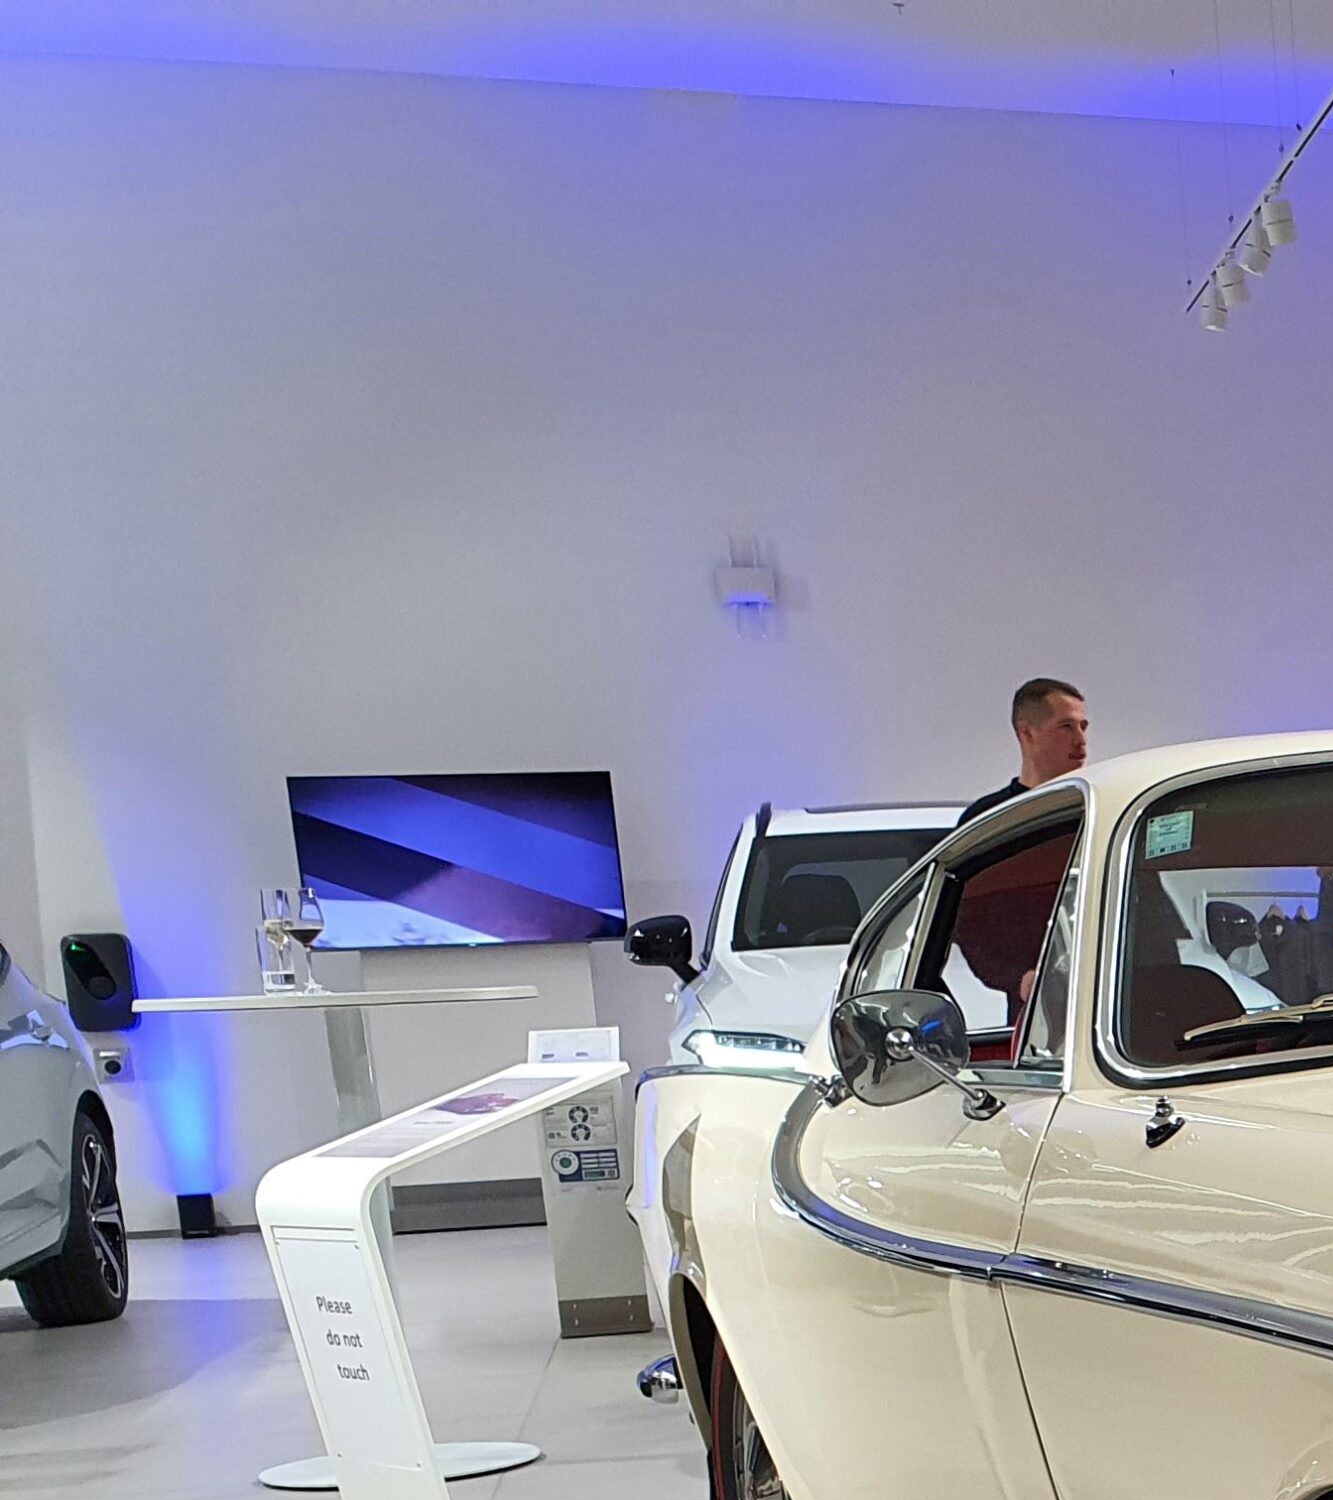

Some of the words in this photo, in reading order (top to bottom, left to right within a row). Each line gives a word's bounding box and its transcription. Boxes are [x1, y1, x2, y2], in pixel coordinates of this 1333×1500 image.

[316, 1295, 352, 1315] Please
[326, 1328, 341, 1346] do
[343, 1333, 363, 1348] not
[337, 1363, 370, 1381] touch
